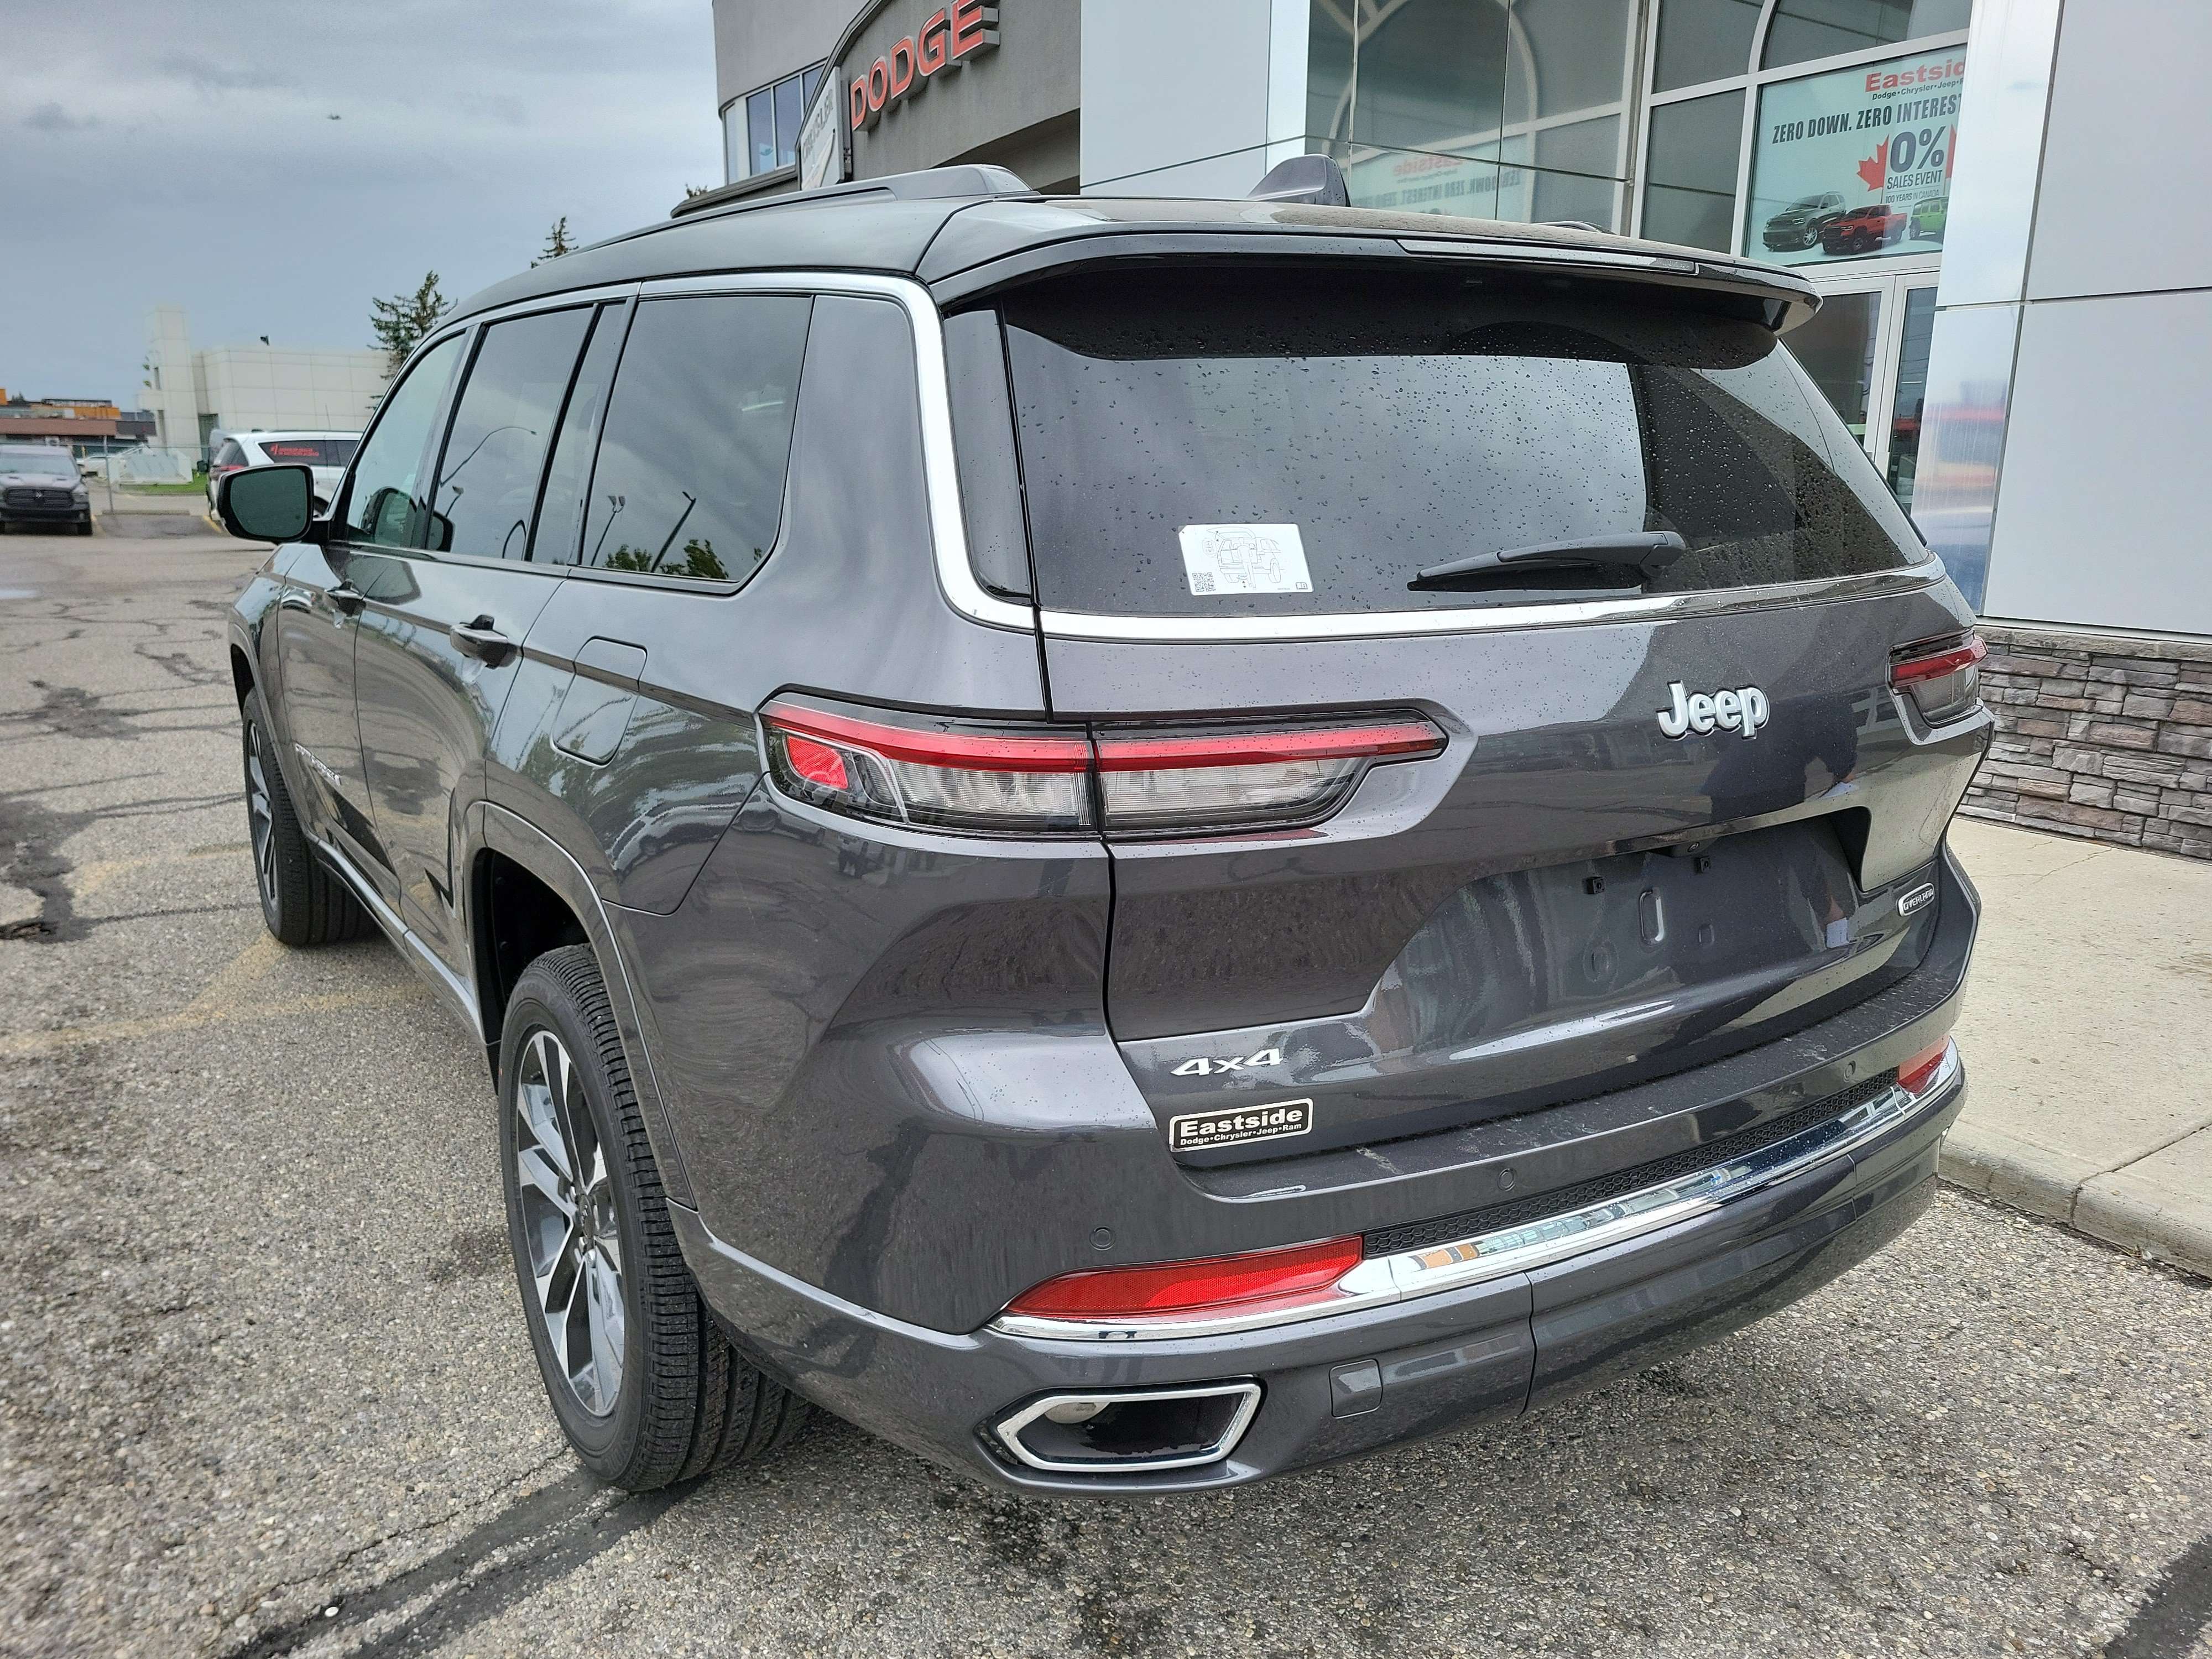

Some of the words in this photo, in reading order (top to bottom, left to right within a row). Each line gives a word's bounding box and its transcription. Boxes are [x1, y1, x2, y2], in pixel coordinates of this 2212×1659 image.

[851, 0, 987, 131] DODGE
[1772, 121, 1803, 144] ZERO
[1808, 113, 1851, 138] DOWN.
[1856, 106, 1892, 129] ZERO
[1890, 126, 1946, 173] 0%
[1887, 174, 1913, 189] SALES
[1915, 170, 1942, 185] EVENT
[1896, 193, 1912, 202] YEARS
[1919, 189, 1939, 199] CANADA
[1656, 681, 1769, 740] Jeep
[1170, 1048, 1284, 1076] 4x4
[1180, 1108, 1303, 1138] Eastside
